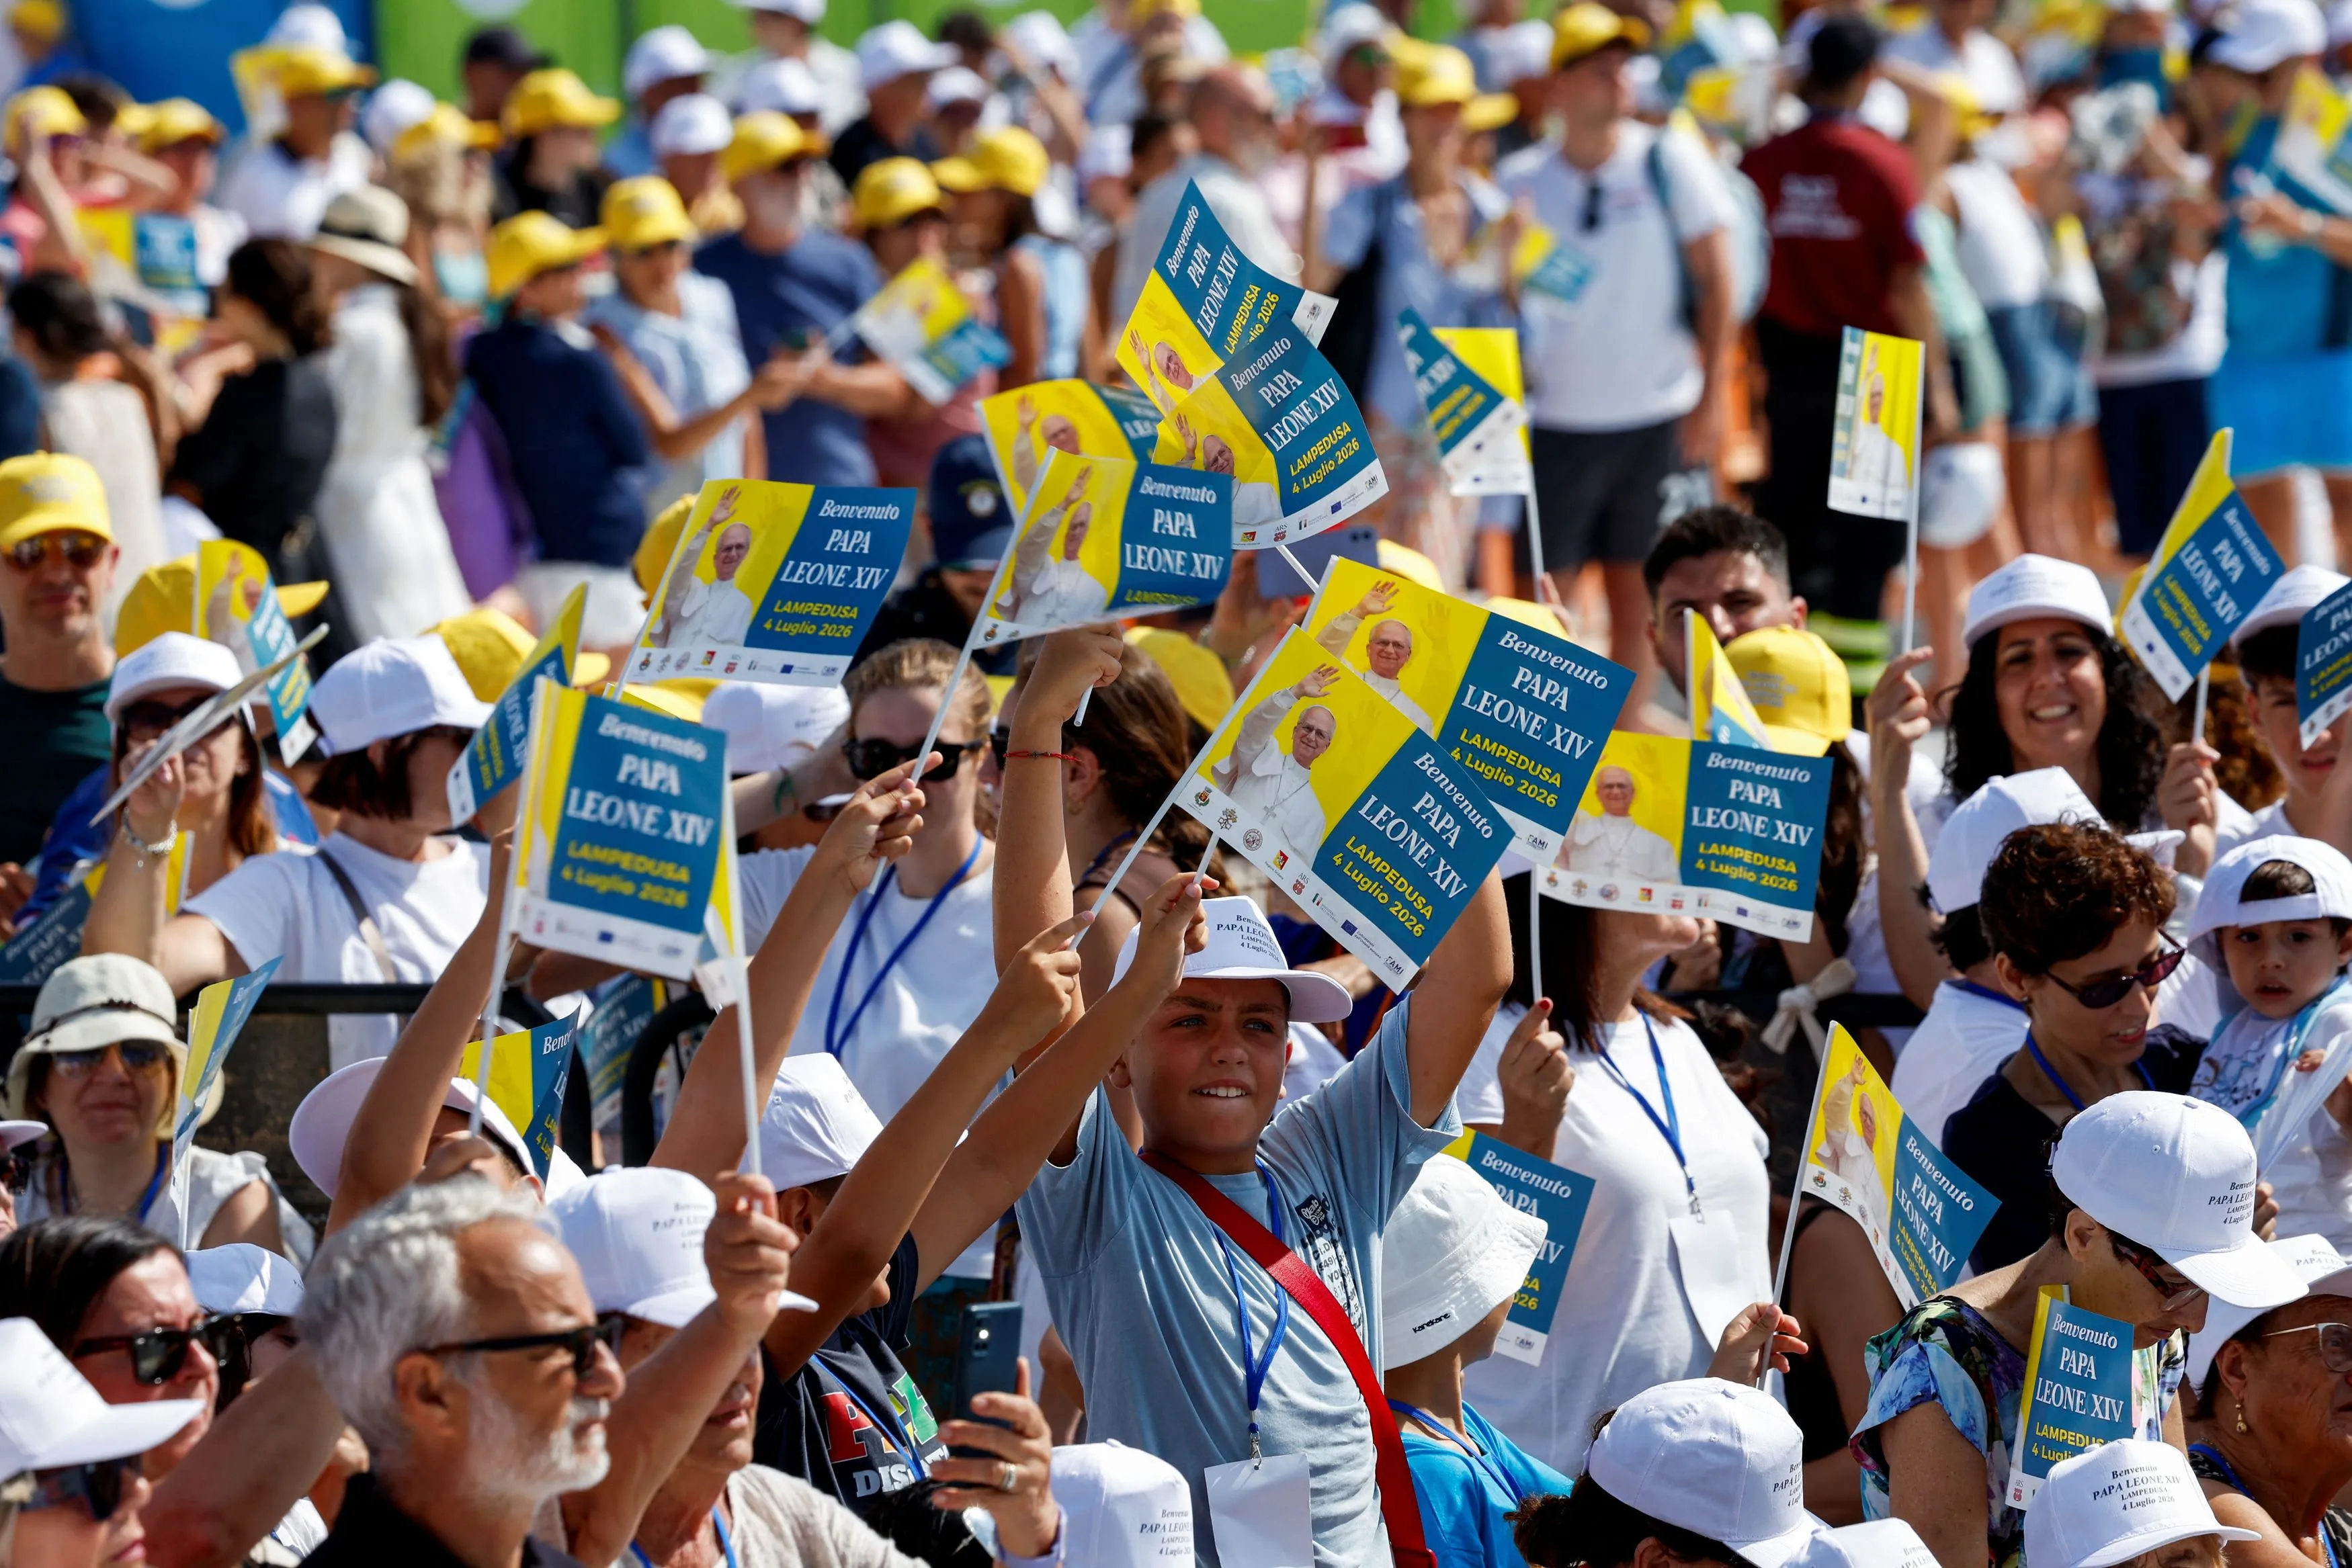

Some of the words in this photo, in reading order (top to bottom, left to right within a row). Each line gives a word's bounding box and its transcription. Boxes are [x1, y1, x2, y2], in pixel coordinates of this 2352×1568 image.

[1166, 205, 1200, 278] Benvenuto
[1186, 242, 1211, 289] PAPA
[1196, 274, 1229, 338] LEONE
[1222, 245, 1239, 292] XIV
[1258, 292, 1279, 324] 2026
[1224, 284, 1261, 355] LAMPEDUSA
[1230, 337, 1292, 392] Benvenuto
[1258, 369, 1303, 408] PAPA
[1264, 403, 1318, 451] LEONE
[1313, 378, 1341, 415] XIV
[1290, 421, 1351, 476] LAMPEDUSA
[1292, 482, 1300, 494] 4
[1303, 460, 1335, 490] Luglio
[1335, 437, 1360, 464] 2026
[818, 499, 900, 520] Benvenuto
[1139, 476, 1217, 505] Benvenuto
[824, 529, 872, 554] PAPA
[1152, 509, 1197, 539] PAPA
[1275, 523, 1288, 532] ARS
[2223, 507, 2271, 576] Benvenuto
[780, 560, 851, 588] LEONE
[849, 566, 890, 591] XIV
[1125, 543, 1187, 577] LEONE
[1190, 554, 1224, 580] XIV
[2178, 541, 2218, 600] LEONE
[2212, 589, 2242, 625] XIV
[2212, 539, 2247, 584] PAPA
[764, 619, 772, 630] 4
[775, 620, 816, 637] Luglio
[819, 623, 853, 638] 2026
[773, 600, 858, 619] LAMPEDUSA
[2164, 574, 2212, 642] LAMPEDUSA
[1497, 629, 1609, 691] Benvenuto
[2304, 624, 2352, 670] LEON
[1511, 666, 1570, 713] PAPA
[598, 713, 707, 763] Benvenuto
[1462, 685, 1547, 741] LEONE
[1548, 722, 1594, 760] XIV
[616, 754, 681, 797] PAPA
[1450, 747, 1462, 763] 4
[1464, 753, 1517, 790] Luglio
[1517, 779, 1558, 808] 2026
[1459, 728, 1562, 789] LAMPEDUSA
[1706, 752, 1810, 784] Benvenuto
[1413, 752, 1493, 839] Benvenuto
[1728, 779, 1782, 809] PAPA
[566, 787, 663, 836] LEONE
[664, 811, 714, 846] XIV
[1412, 791, 1462, 850] PAPA
[1691, 806, 1768, 838] LEONE
[1771, 818, 1814, 847] XIV
[567, 840, 690, 883] LAMPEDUSA
[1357, 795, 1435, 869] LEONE
[1428, 857, 1468, 899] XIV
[1698, 842, 1798, 874] LAMPEDUSA
[1298, 873, 1310, 884] ARS
[1333, 853, 1342, 866] 4
[1343, 861, 1389, 904] Luglio
[1389, 901, 1426, 938] 2026
[1345, 836, 1433, 920] LAMPEDUSA
[1695, 859, 1706, 871] 4
[1710, 861, 1756, 883] Luglio
[1759, 873, 1798, 892] 2026
[1217, 924, 1244, 932] PAPA
[1241, 934, 1275, 953] LAMPEDUSA
[1247, 943, 1267, 953] Luglio
[1481, 1149, 1572, 1199] Benvenuto
[1906, 1134, 1974, 1211] Benvenuto
[1912, 1172, 1944, 1226] PAPA
[2208, 1195, 2233, 1205] PAPA
[1894, 1178, 1931, 1248] LEONE
[1928, 1234, 1956, 1273] XIV
[1897, 1218, 1937, 1294] LAMPEDUSA
[1901, 1242, 1920, 1282] Luglio
[2052, 1313, 2117, 1350] Benvenuto
[2059, 1346, 2097, 1381] PAPA
[2036, 1377, 2087, 1415] LEONE
[2092, 1393, 2124, 1424] XIV
[2031, 1443, 2039, 1456] 4
[1773, 1477, 1793, 1492] PAPA
[2014, 1479, 2023, 1487] ARS
[2093, 1483, 2124, 1501] PAPA
[2126, 1475, 2164, 1489] LEONE
[2165, 1474, 2181, 1485] XIV
[2111, 1465, 2157, 1480] Benvenuto
[2121, 1487, 2168, 1501] LAMPEDUSA
[2122, 1503, 2127, 1511] 4
[2130, 1497, 2156, 1510] Luglio
[2158, 1495, 2175, 1504] 2026
[1140, 1524, 1166, 1533] PAPA
